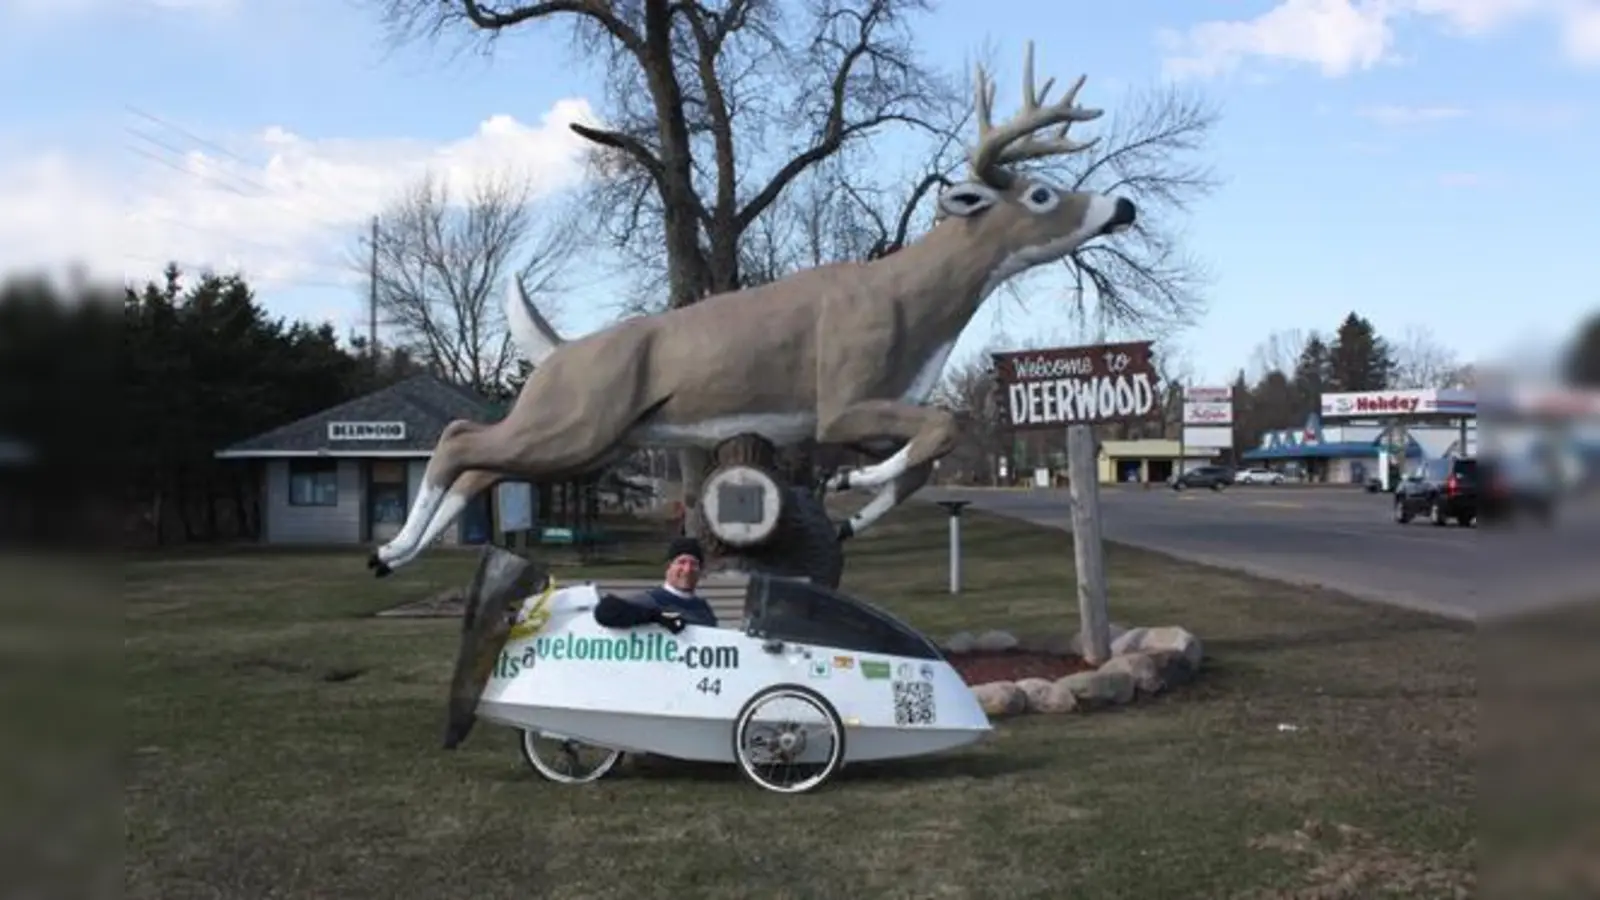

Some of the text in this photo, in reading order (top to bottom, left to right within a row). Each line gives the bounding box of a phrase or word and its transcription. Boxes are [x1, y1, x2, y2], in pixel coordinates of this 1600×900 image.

[1012, 352, 1131, 379] Welcome to
[1009, 373, 1153, 425] DEERWOOD
[696, 677, 722, 696] 44
